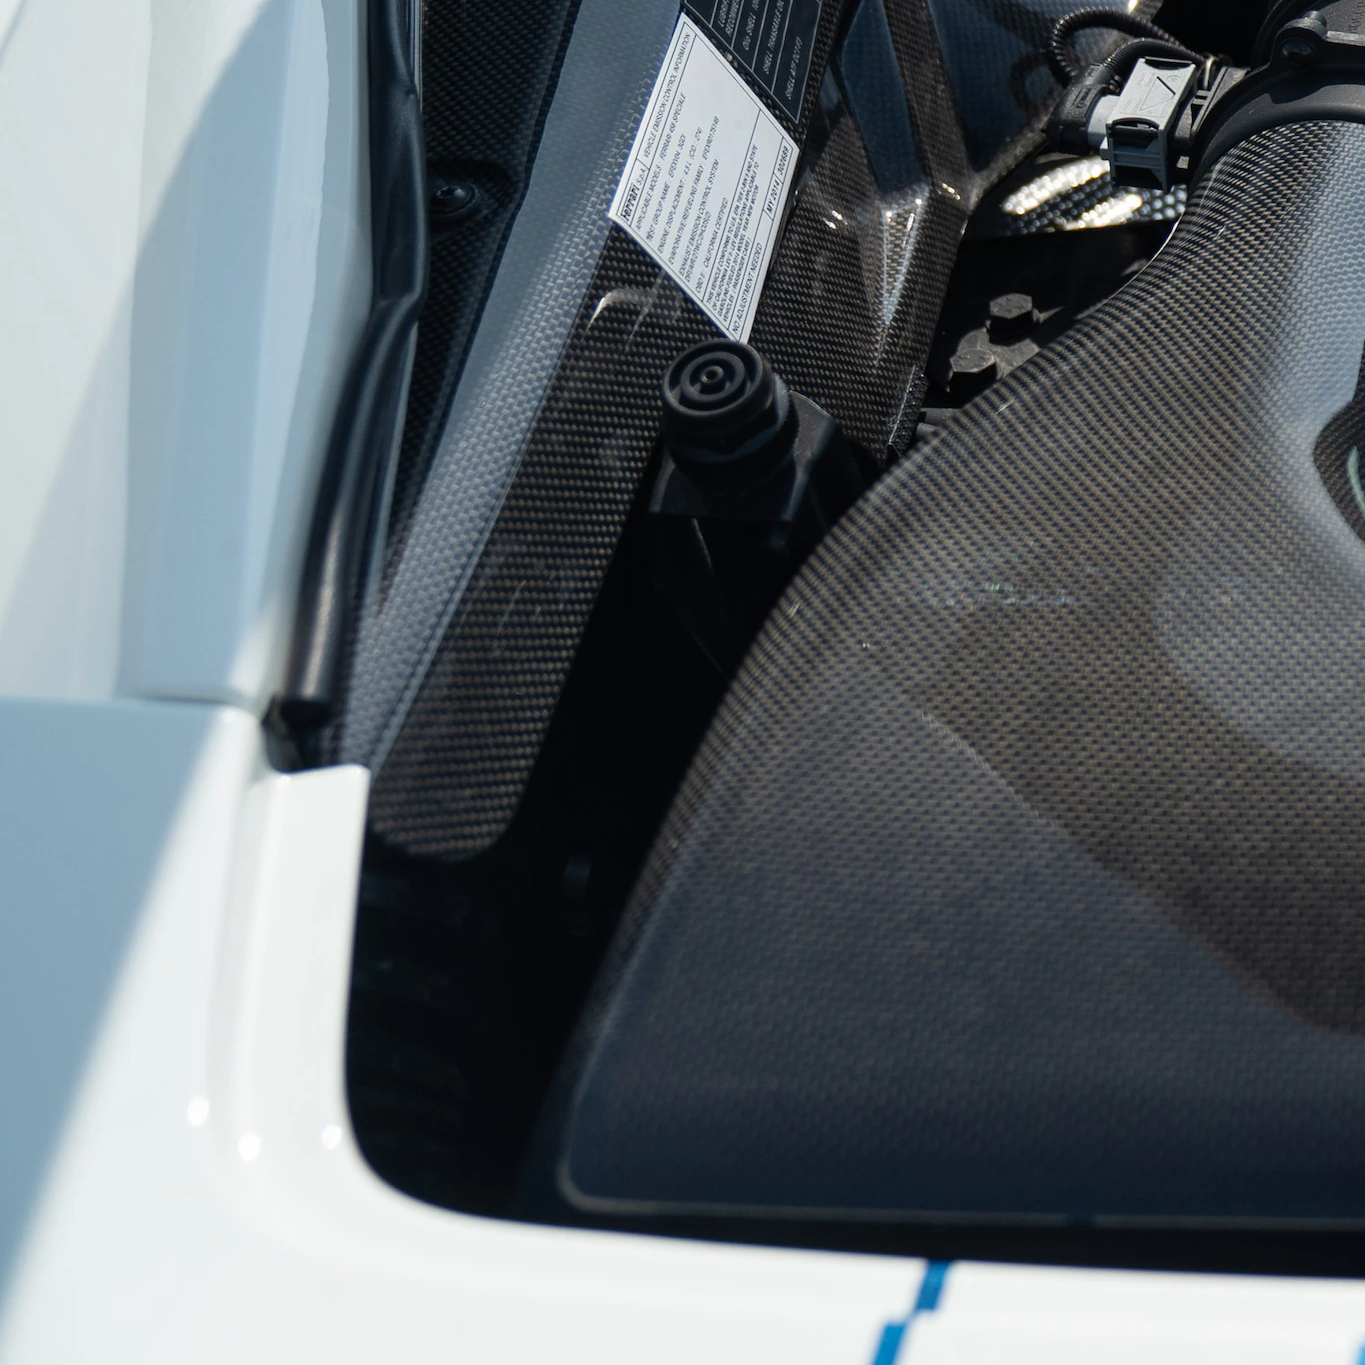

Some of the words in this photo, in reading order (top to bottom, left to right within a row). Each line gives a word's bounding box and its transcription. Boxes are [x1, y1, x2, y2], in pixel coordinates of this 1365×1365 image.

[746, 12, 756, 36] SHELL
[644, 131, 657, 158] VEHICLE
[653, 102, 667, 133] EMISSION
[663, 74, 677, 103] CONTROL
[674, 34, 691, 73] INFORMATION
[763, 51, 773, 75] SHELL
[786, 76, 796, 100] SHELL
[637, 191, 653, 230] APPLICABLE
[649, 164, 662, 192] MODELS
[660, 133, 672, 159] FERRARI
[673, 92, 686, 123] SPECIALE
[694, 165, 704, 186] FAMILY
[771, 179, 780, 201] 2014
[621, 184, 640, 222] Ferrari
[647, 224, 655, 241] TEST
[653, 200, 663, 226] GROUP
[661, 181, 671, 201] NAME
[658, 227, 670, 254] ENGINE
[666, 179, 684, 229] DISPLACEMENT
[679, 245, 692, 277] EXHAUST
[689, 213, 702, 247] EMISSION
[699, 186, 712, 215] CONTROL
[708, 158, 719, 185] SYSTEM
[704, 230, 719, 268] CALIFORNIA
[715, 197, 728, 231] CERTIFIED
[711, 266, 722, 291] VEHICLE
[719, 234, 731, 268] CONFORMS
[750, 144, 758, 162] STATE
[715, 268, 728, 302] CALIFORNIA
[734, 201, 748, 240] REGULATIONS
[745, 170, 757, 202] APPLICABLE
[718, 265, 736, 317] GASOLINE-FUELED
[737, 233, 746, 253] MODEL
[751, 184, 759, 205] MOTOR
[737, 272, 754, 321] ADJUSTMENT
[751, 242, 762, 273] NEEDED
[724, 294, 734, 322] VEHICLES
[733, 255, 745, 289] PASSENGER
